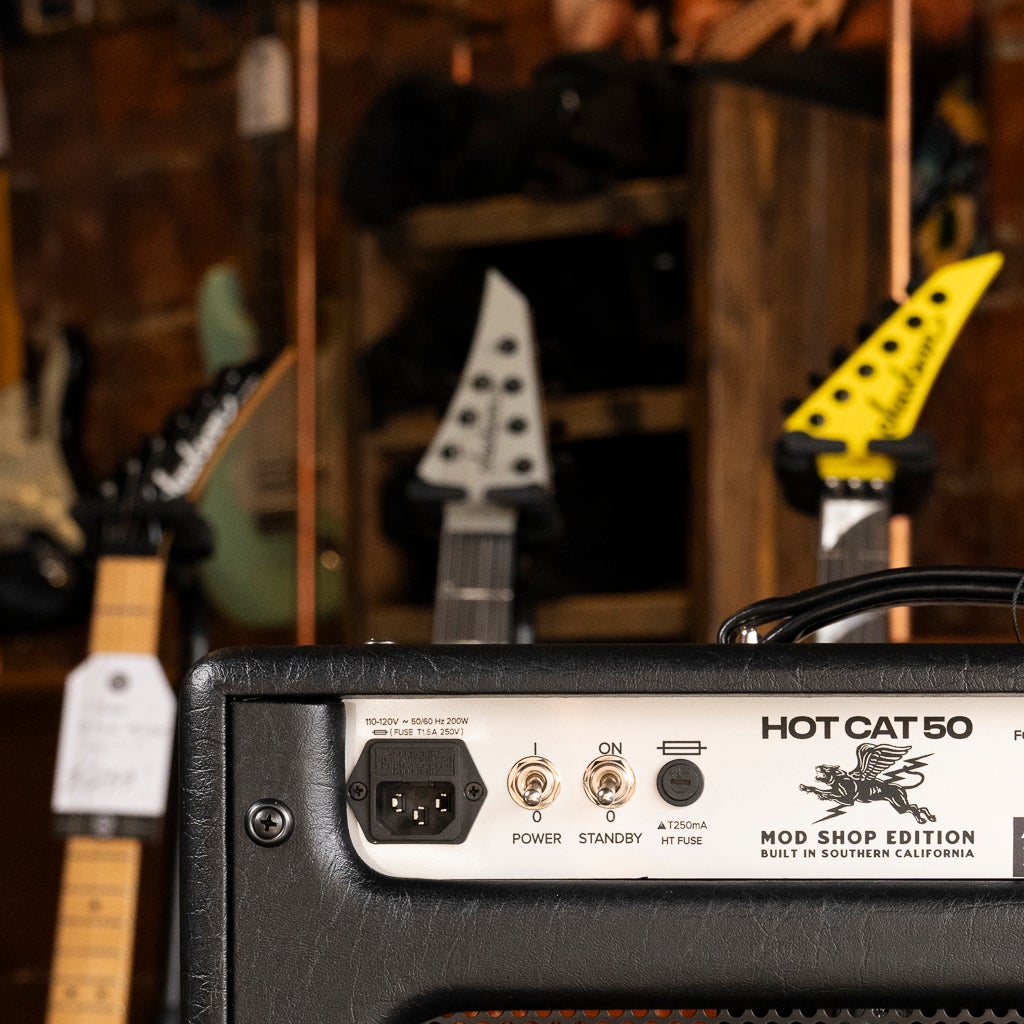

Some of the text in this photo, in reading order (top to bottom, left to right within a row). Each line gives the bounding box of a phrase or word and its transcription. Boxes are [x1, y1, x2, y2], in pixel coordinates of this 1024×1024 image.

[365, 717, 399, 726] 110-120V
[411, 717, 433, 726] 50/60
[434, 717, 445, 725] Hz
[446, 717, 469, 725] 200W
[761, 715, 974, 740] HOT CAT 50
[598, 741, 623, 754] ON
[667, 820, 708, 830] T250mA
[512, 832, 562, 845] POWER
[578, 832, 643, 845] STANDBY
[661, 836, 703, 846] HT FUSE
[760, 829, 975, 845] MOD SHOP EDITION
[760, 848, 975, 859] BUILT IN SOUTHERN CALIFORNIA
